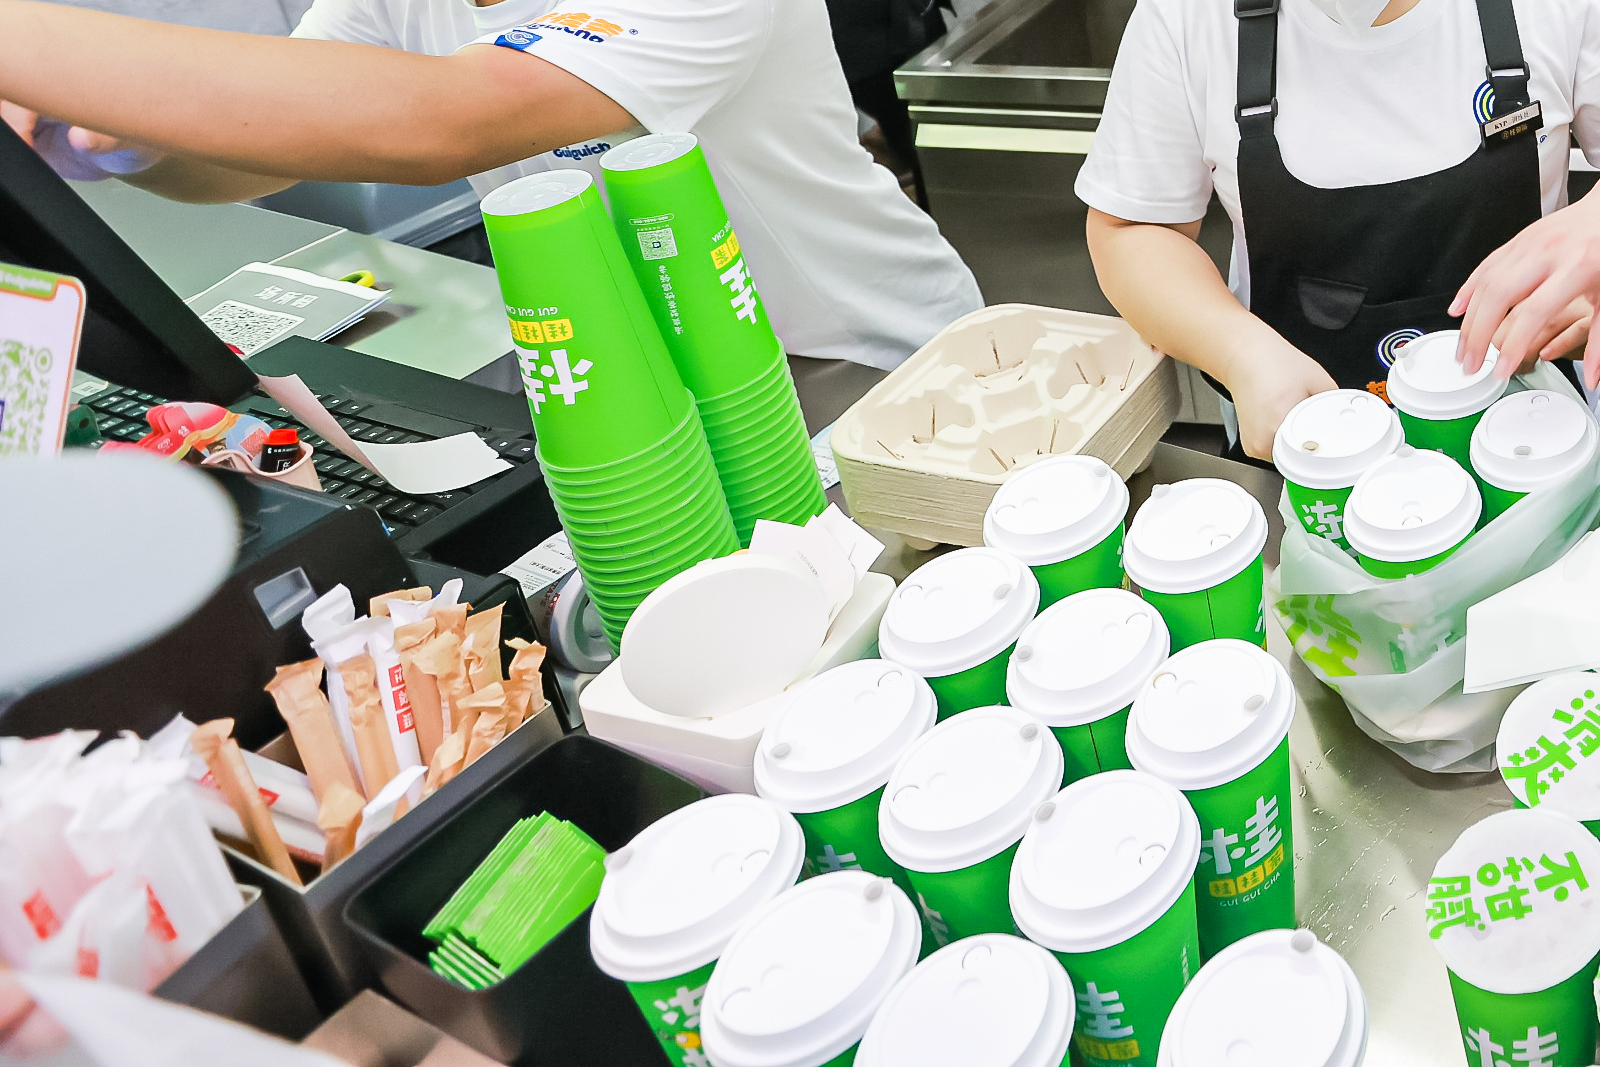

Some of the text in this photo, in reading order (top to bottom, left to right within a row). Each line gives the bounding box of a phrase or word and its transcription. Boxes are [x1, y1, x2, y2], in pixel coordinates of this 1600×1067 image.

[553, 142, 611, 160] Guiguich
[517, 307, 535, 318] GUI
[538, 305, 558, 316] GUI
[1200, 795, 1282, 875] 桂
[1219, 872, 1281, 908] GUI GUI CHA
